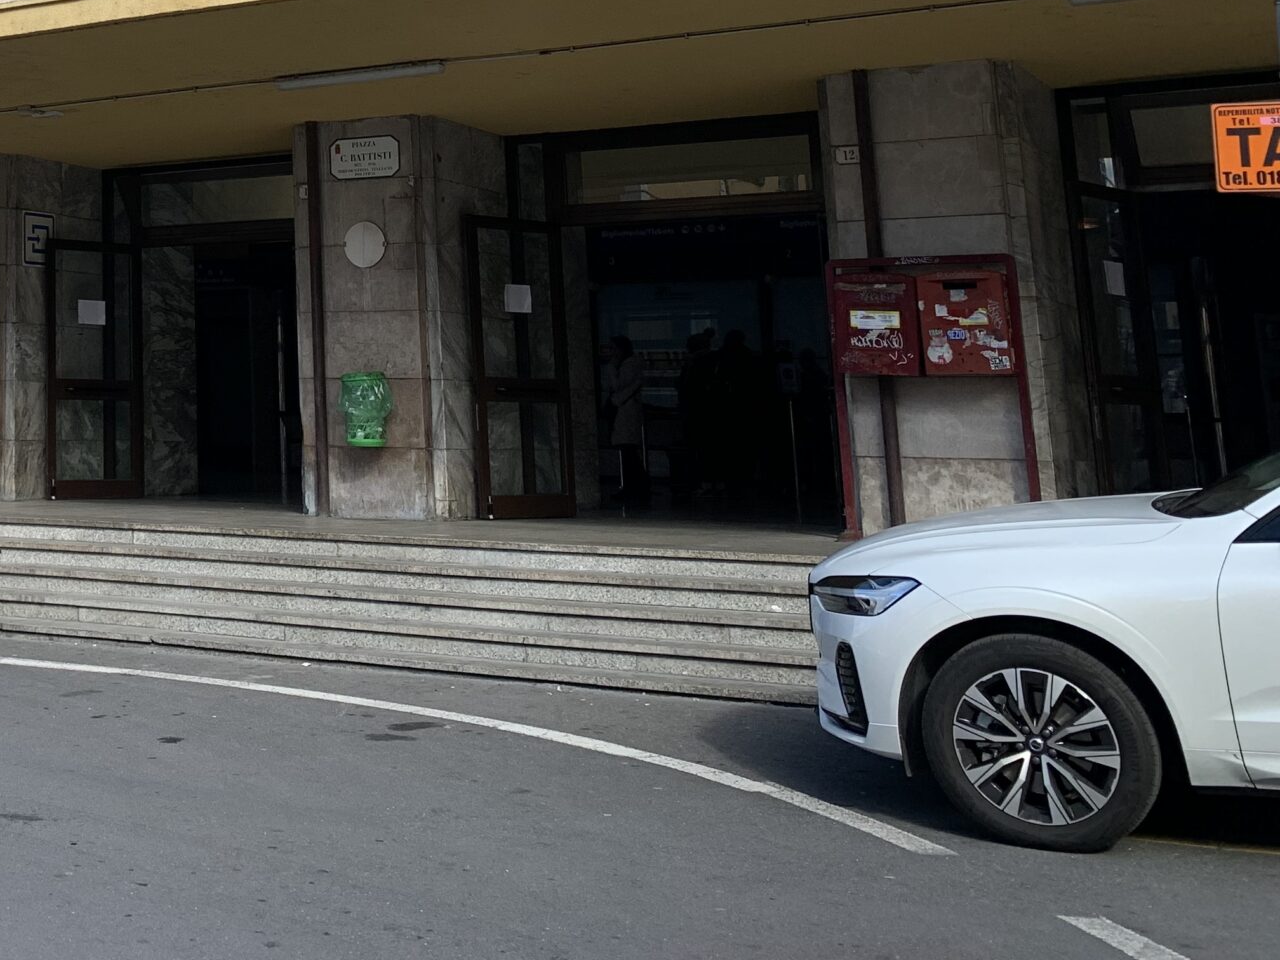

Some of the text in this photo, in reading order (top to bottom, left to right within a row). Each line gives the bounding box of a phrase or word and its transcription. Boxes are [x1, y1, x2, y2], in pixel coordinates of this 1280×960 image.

[350, 152, 392, 161] BATTISTI
[843, 150, 856, 160] 12
[1222, 171, 1253, 186] Tel.
